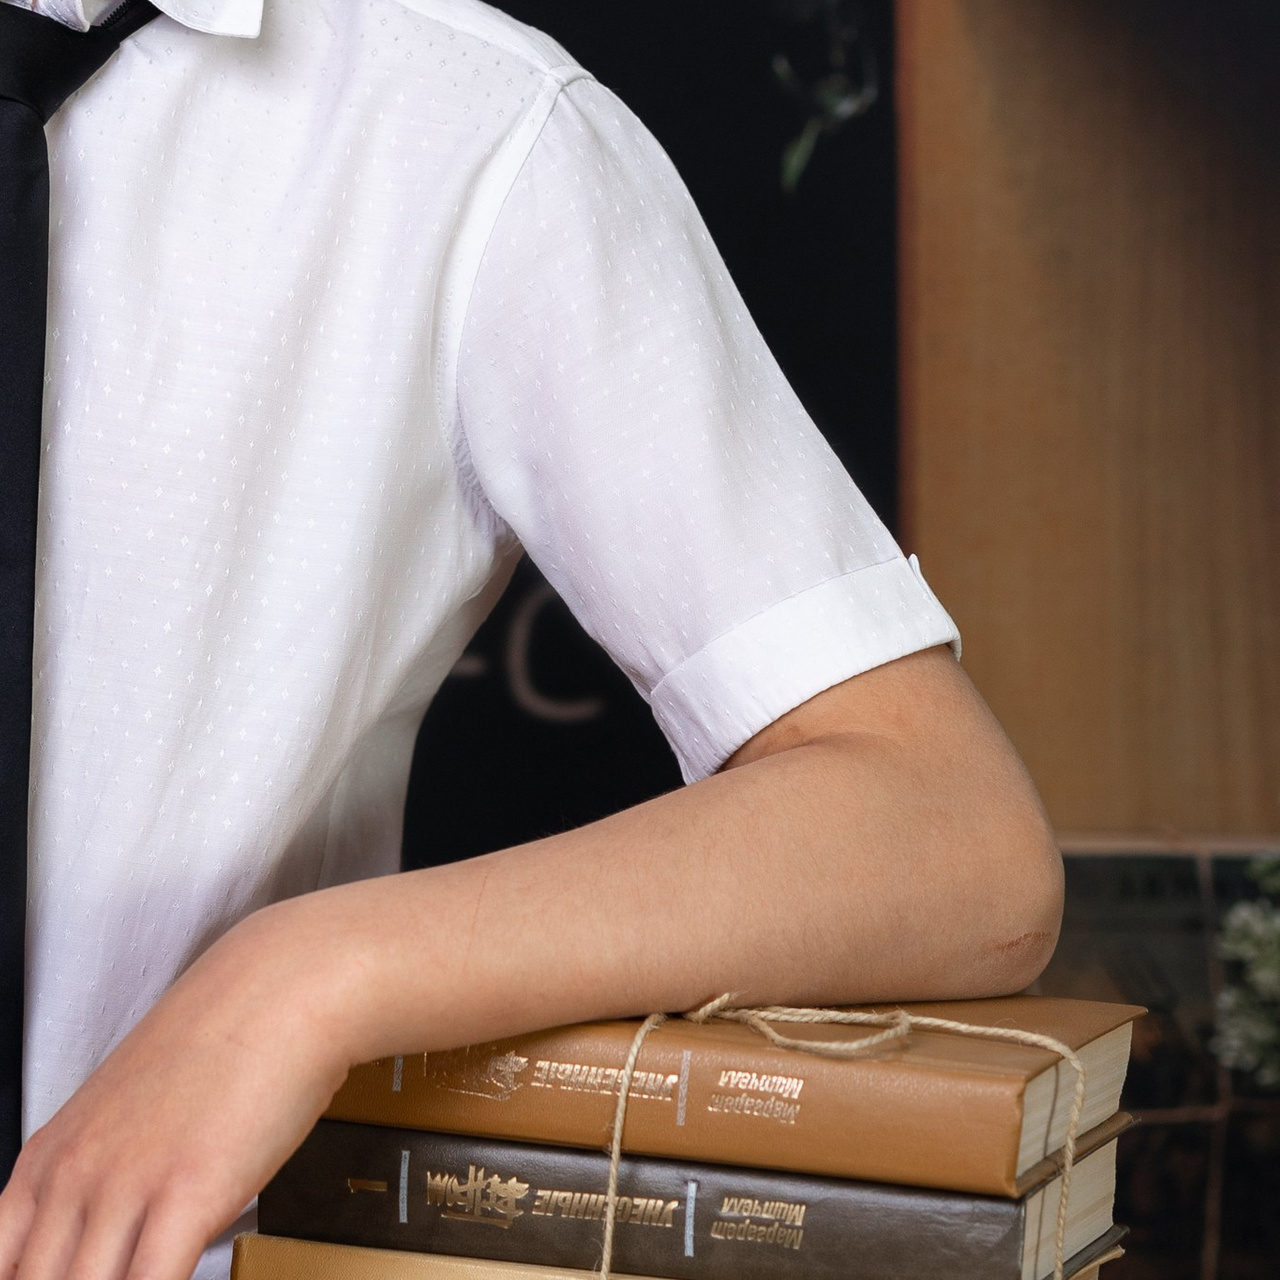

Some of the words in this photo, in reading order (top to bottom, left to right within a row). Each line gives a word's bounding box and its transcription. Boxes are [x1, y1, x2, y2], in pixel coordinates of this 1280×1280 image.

[719, 1070, 804, 1099] Митчелл
[721, 1197, 806, 1226] Митчелл
[710, 1219, 804, 1250] Маргарет
